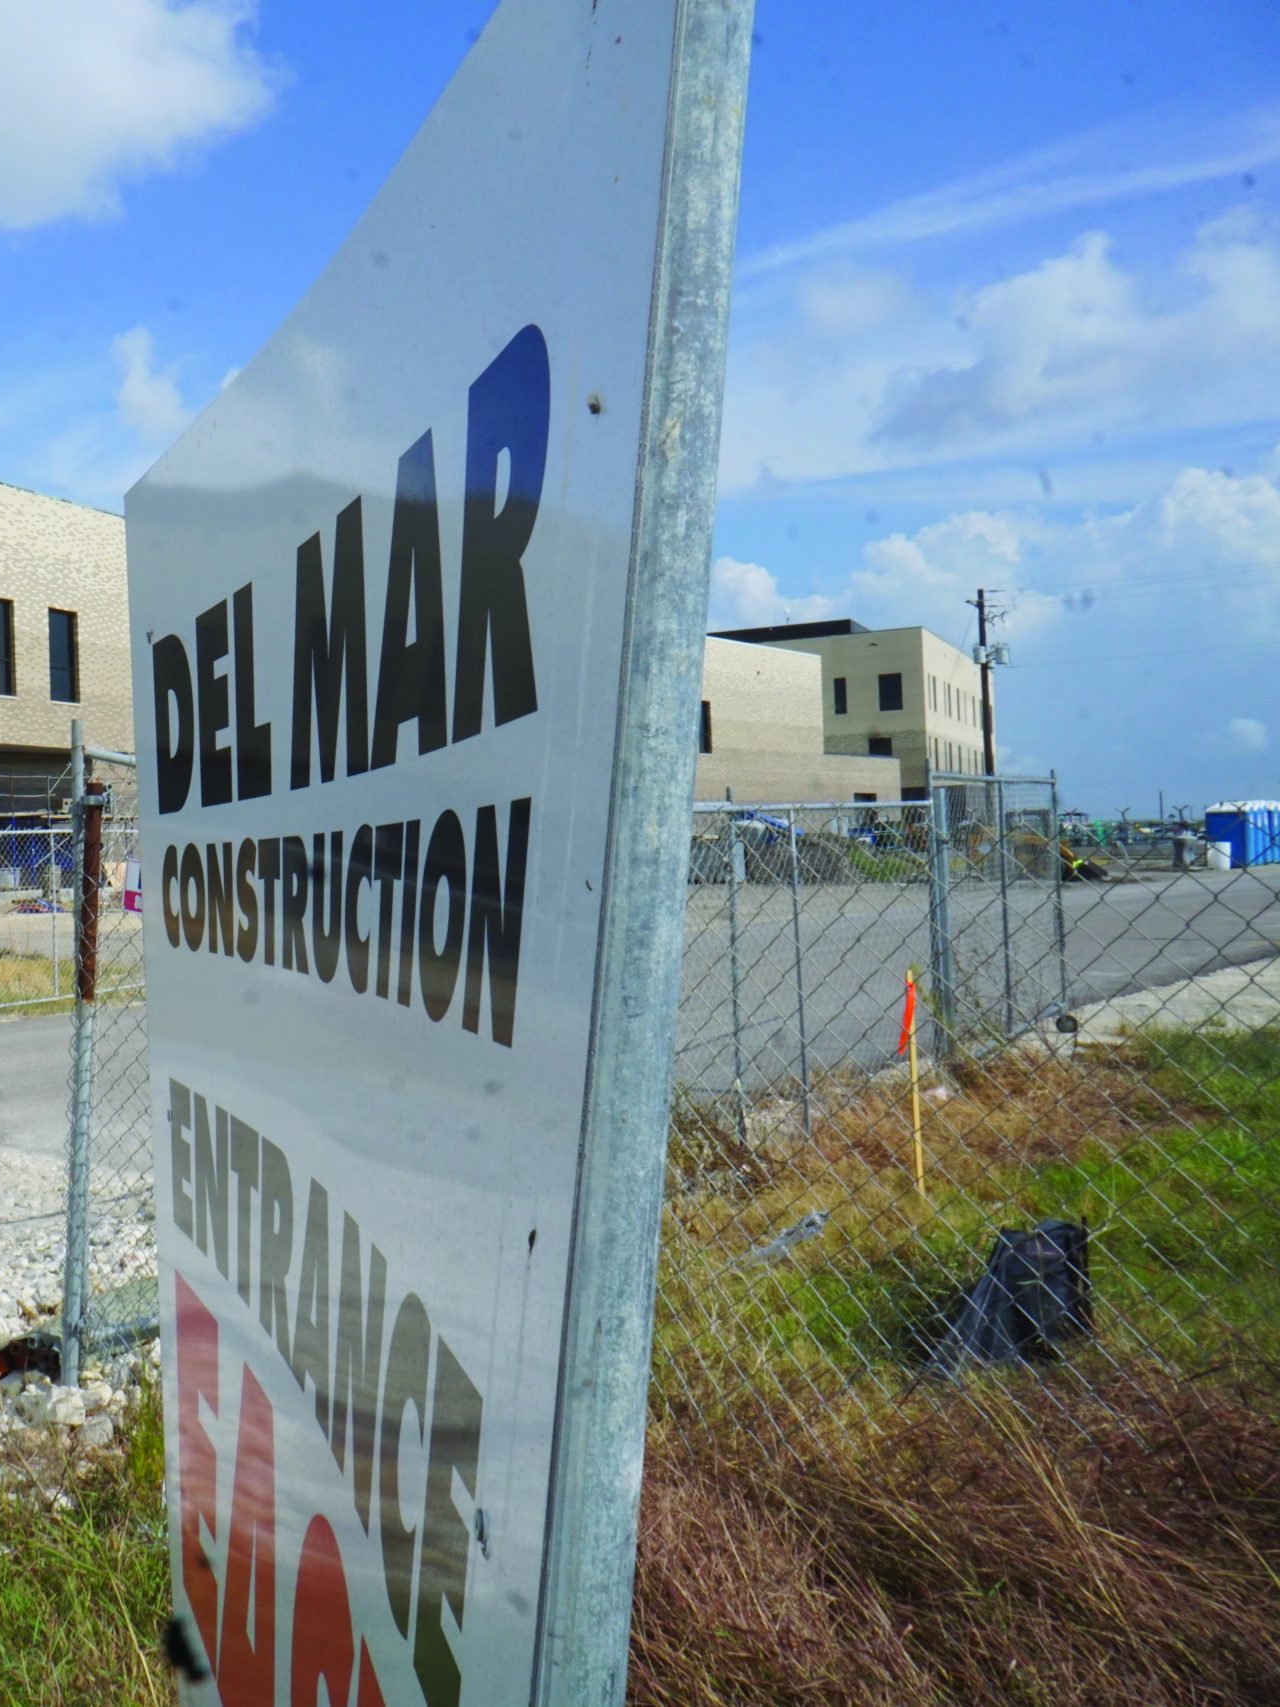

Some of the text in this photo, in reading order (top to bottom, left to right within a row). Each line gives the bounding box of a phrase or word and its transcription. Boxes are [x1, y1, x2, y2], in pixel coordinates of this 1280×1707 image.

[152, 323, 551, 815] DEL MAR
[162, 796, 532, 1049] CONSTRUCTION
[168, 1076, 484, 1707] ENTRANCE
